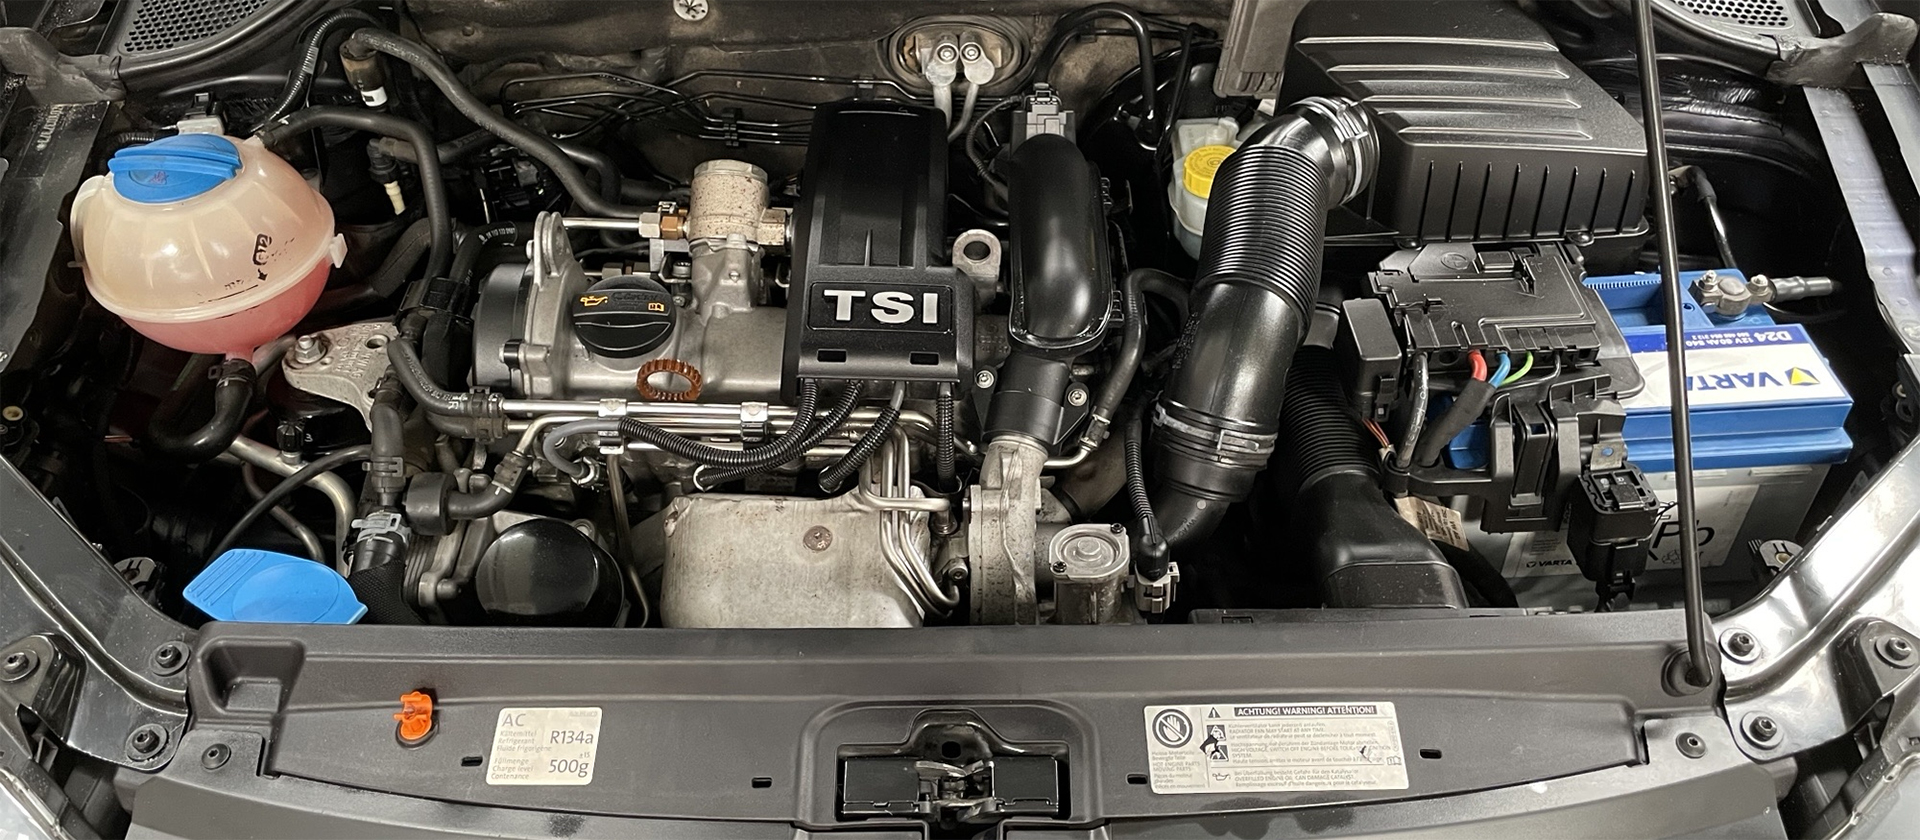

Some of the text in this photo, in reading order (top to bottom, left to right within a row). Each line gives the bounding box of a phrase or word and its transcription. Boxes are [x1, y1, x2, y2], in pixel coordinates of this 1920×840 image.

[824, 289, 938, 324] TSI
[1754, 331, 1792, 341] D24
[1539, 559, 1572, 567] VARTA
[1327, 706, 1374, 714] ATTENTION!
[502, 713, 526, 727] AC
[550, 730, 594, 744] R134a
[548, 759, 589, 778] 500g
